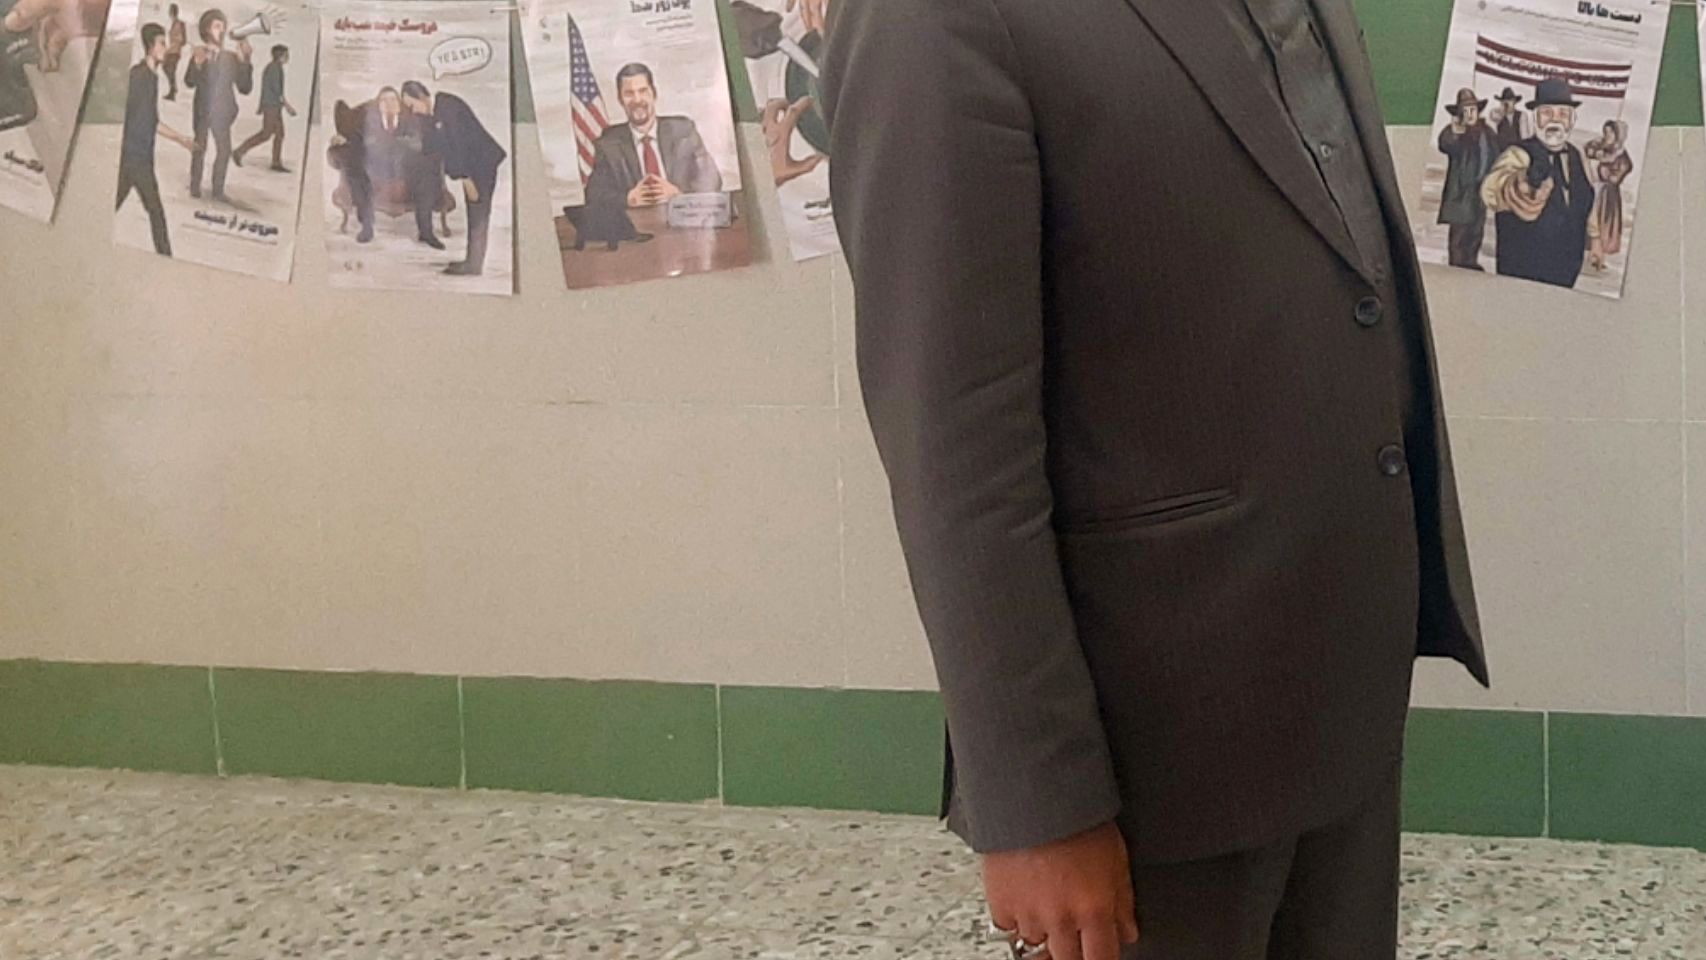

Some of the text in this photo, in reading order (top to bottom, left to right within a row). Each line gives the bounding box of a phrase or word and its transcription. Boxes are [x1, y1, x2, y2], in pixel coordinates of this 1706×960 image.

[1577, 0, 1643, 24] دست ها بالا
